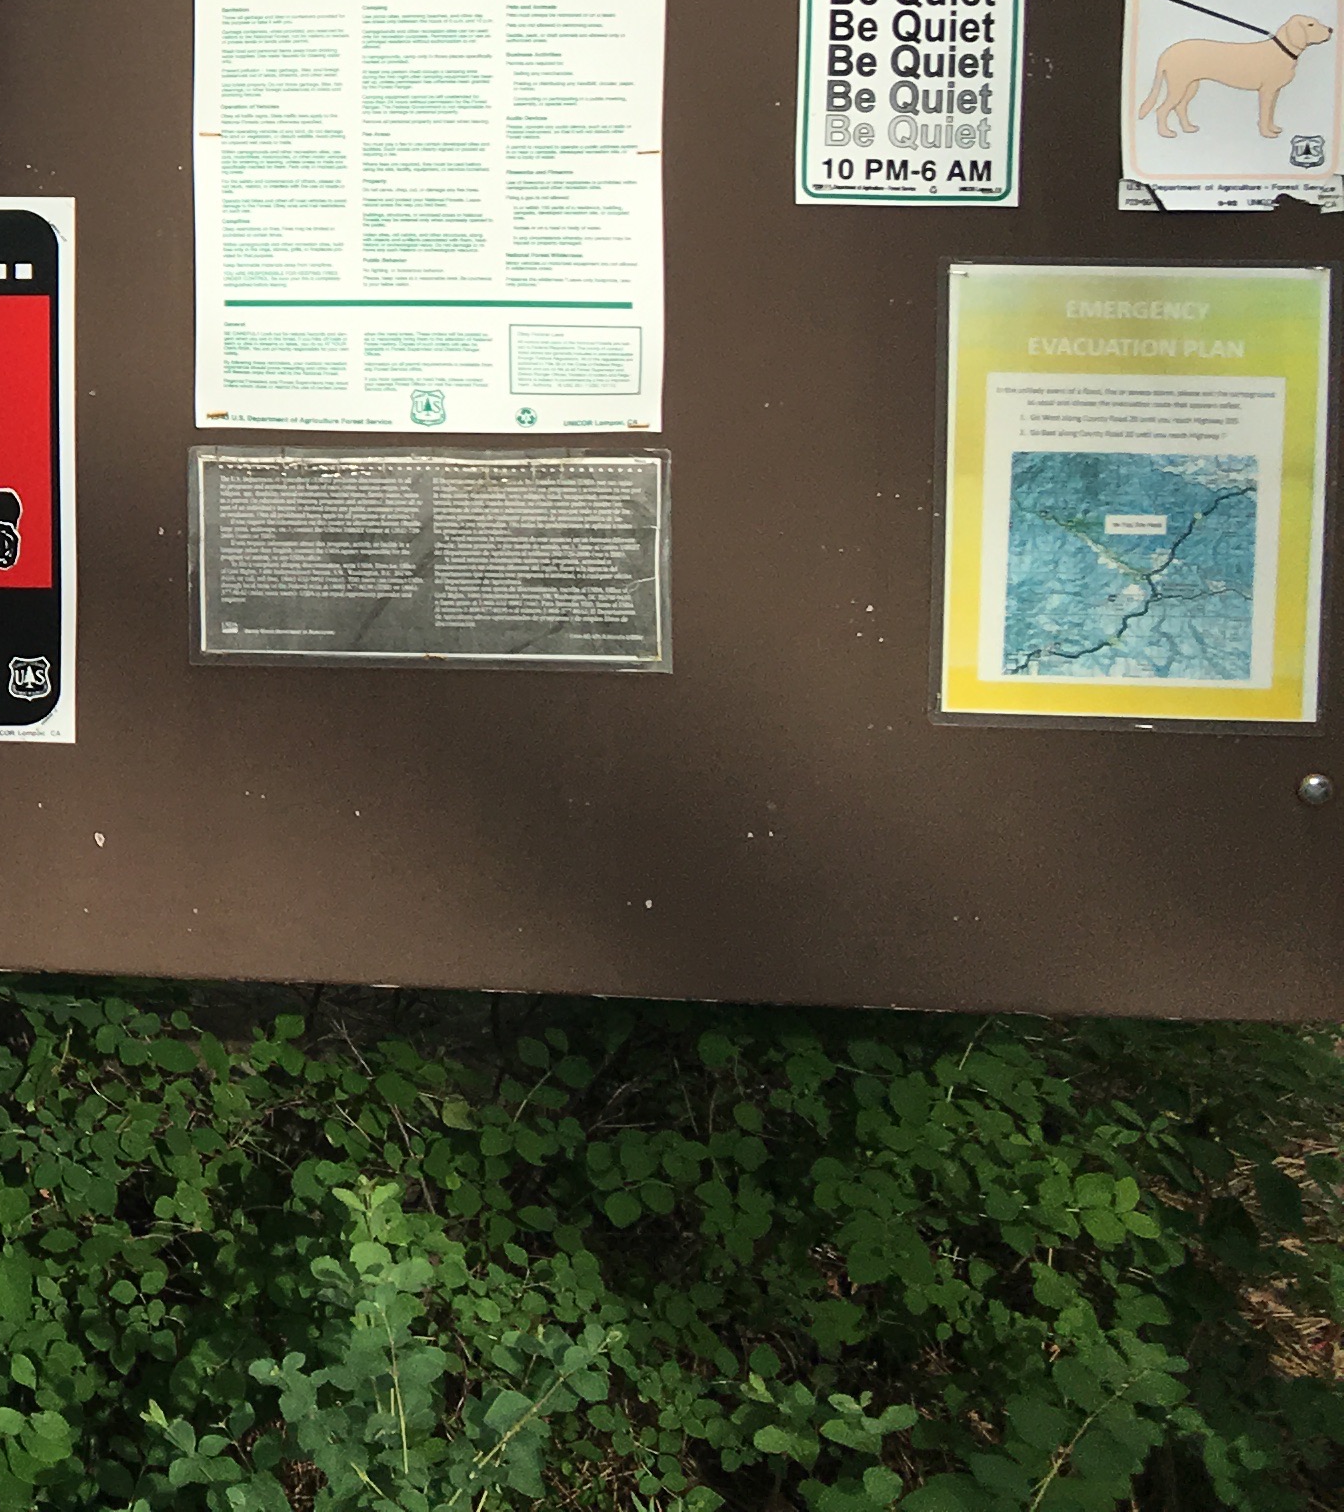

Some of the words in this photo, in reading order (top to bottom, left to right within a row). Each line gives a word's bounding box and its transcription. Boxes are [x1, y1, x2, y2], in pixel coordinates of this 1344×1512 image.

[828, 8, 879, 46] Be
[891, 8, 996, 46] Quiet
[827, 44, 878, 78] Be
[890, 44, 994, 80] Quiet
[826, 79, 876, 116] Be
[889, 79, 993, 116] Quiet
[822, 114, 876, 150] Be
[887, 114, 992, 151] Quiet
[821, 158, 855, 182] 10
[865, 158, 937, 182] PM-6
[945, 159, 993, 182] AM
[1066, 301, 1209, 320] EMERGENCY
[1027, 337, 1176, 357] EVACUATION
[1183, 340, 1245, 359] PLAN
